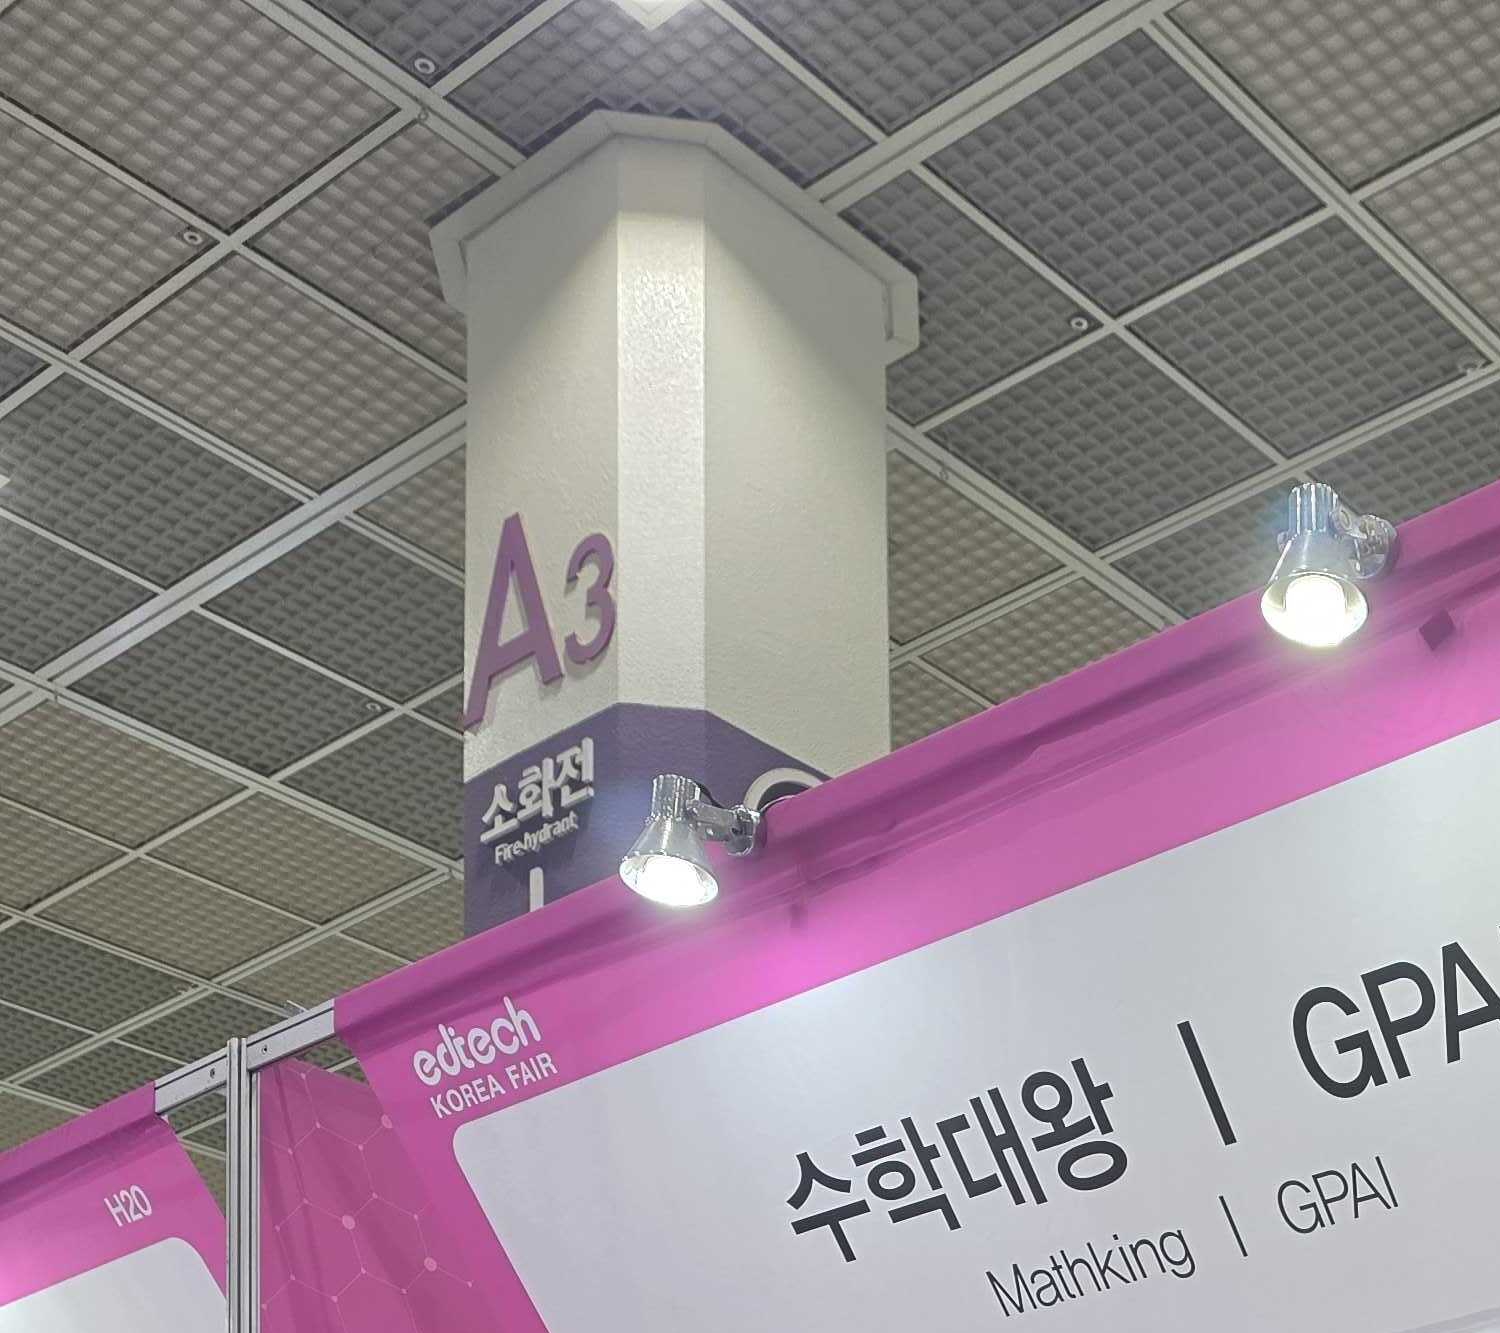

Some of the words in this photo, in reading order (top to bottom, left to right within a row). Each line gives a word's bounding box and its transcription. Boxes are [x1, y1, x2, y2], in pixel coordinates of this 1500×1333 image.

[463, 512, 618, 734] A3
[479, 736, 595, 845] 소화전
[413, 997, 541, 1087] edtech
[429, 1076, 505, 1119] KOREA
[505, 1051, 558, 1098] FAIR
[104, 1184, 153, 1227] H20
[786, 1057, 1129, 1263] 수학대왕
[985, 1226, 1197, 1318] Mathking
[1276, 1155, 1399, 1236] GPAI
